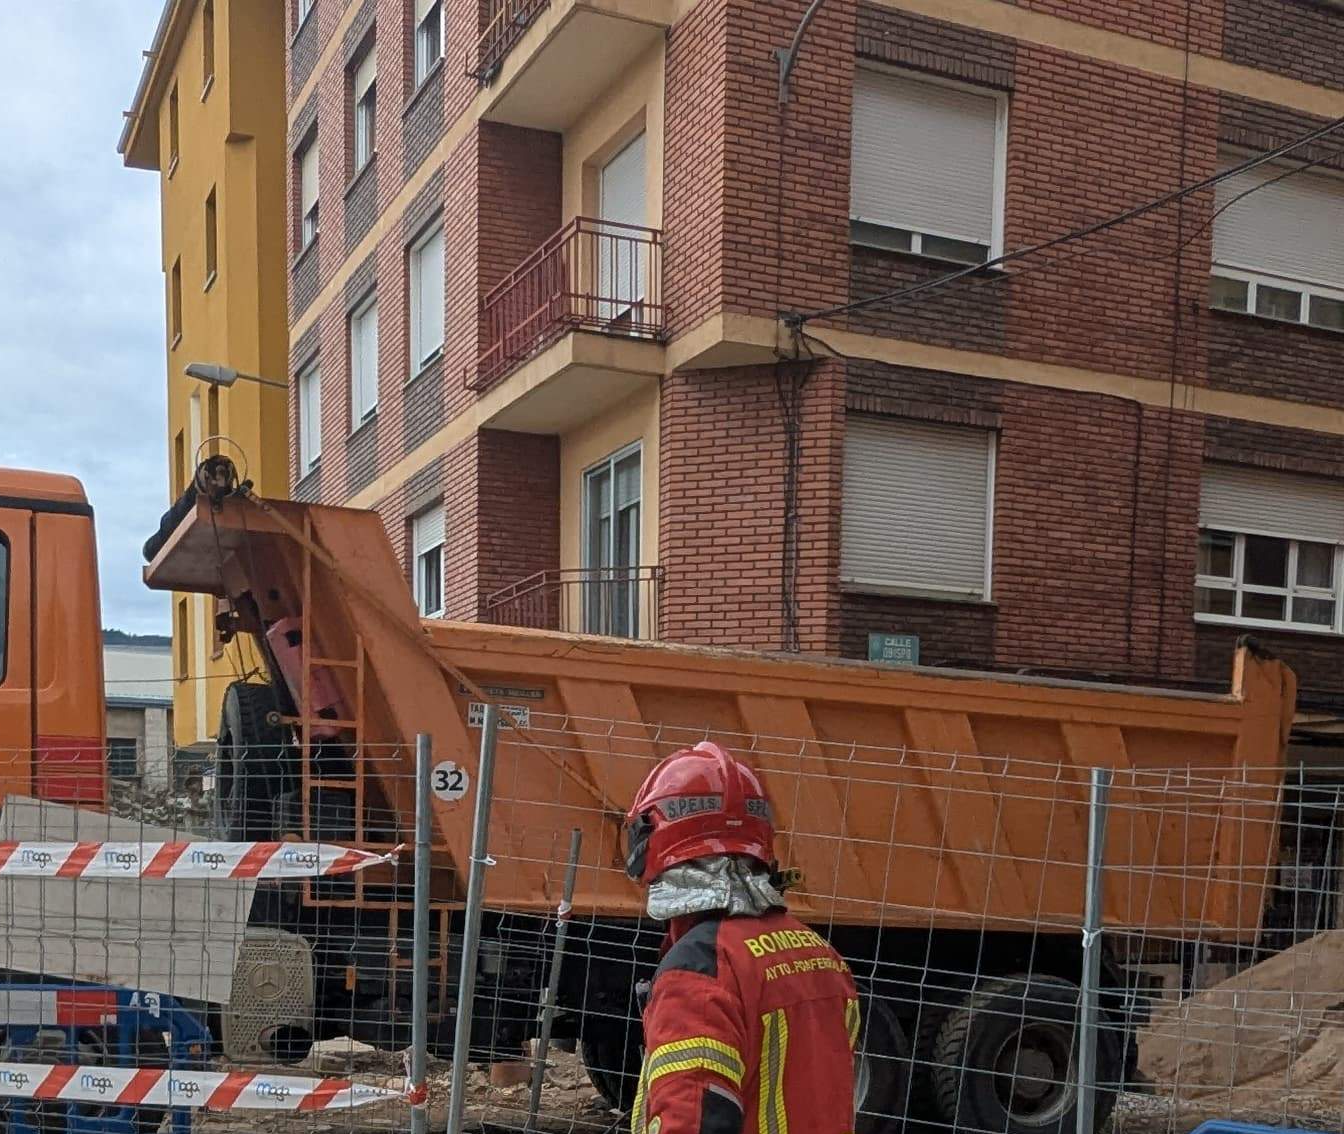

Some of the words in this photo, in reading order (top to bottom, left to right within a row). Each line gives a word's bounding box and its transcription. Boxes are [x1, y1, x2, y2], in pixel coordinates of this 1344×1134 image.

[885, 637, 912, 648] CALLE
[435, 769, 464, 792] 32
[743, 930, 830, 957] BOMBER
